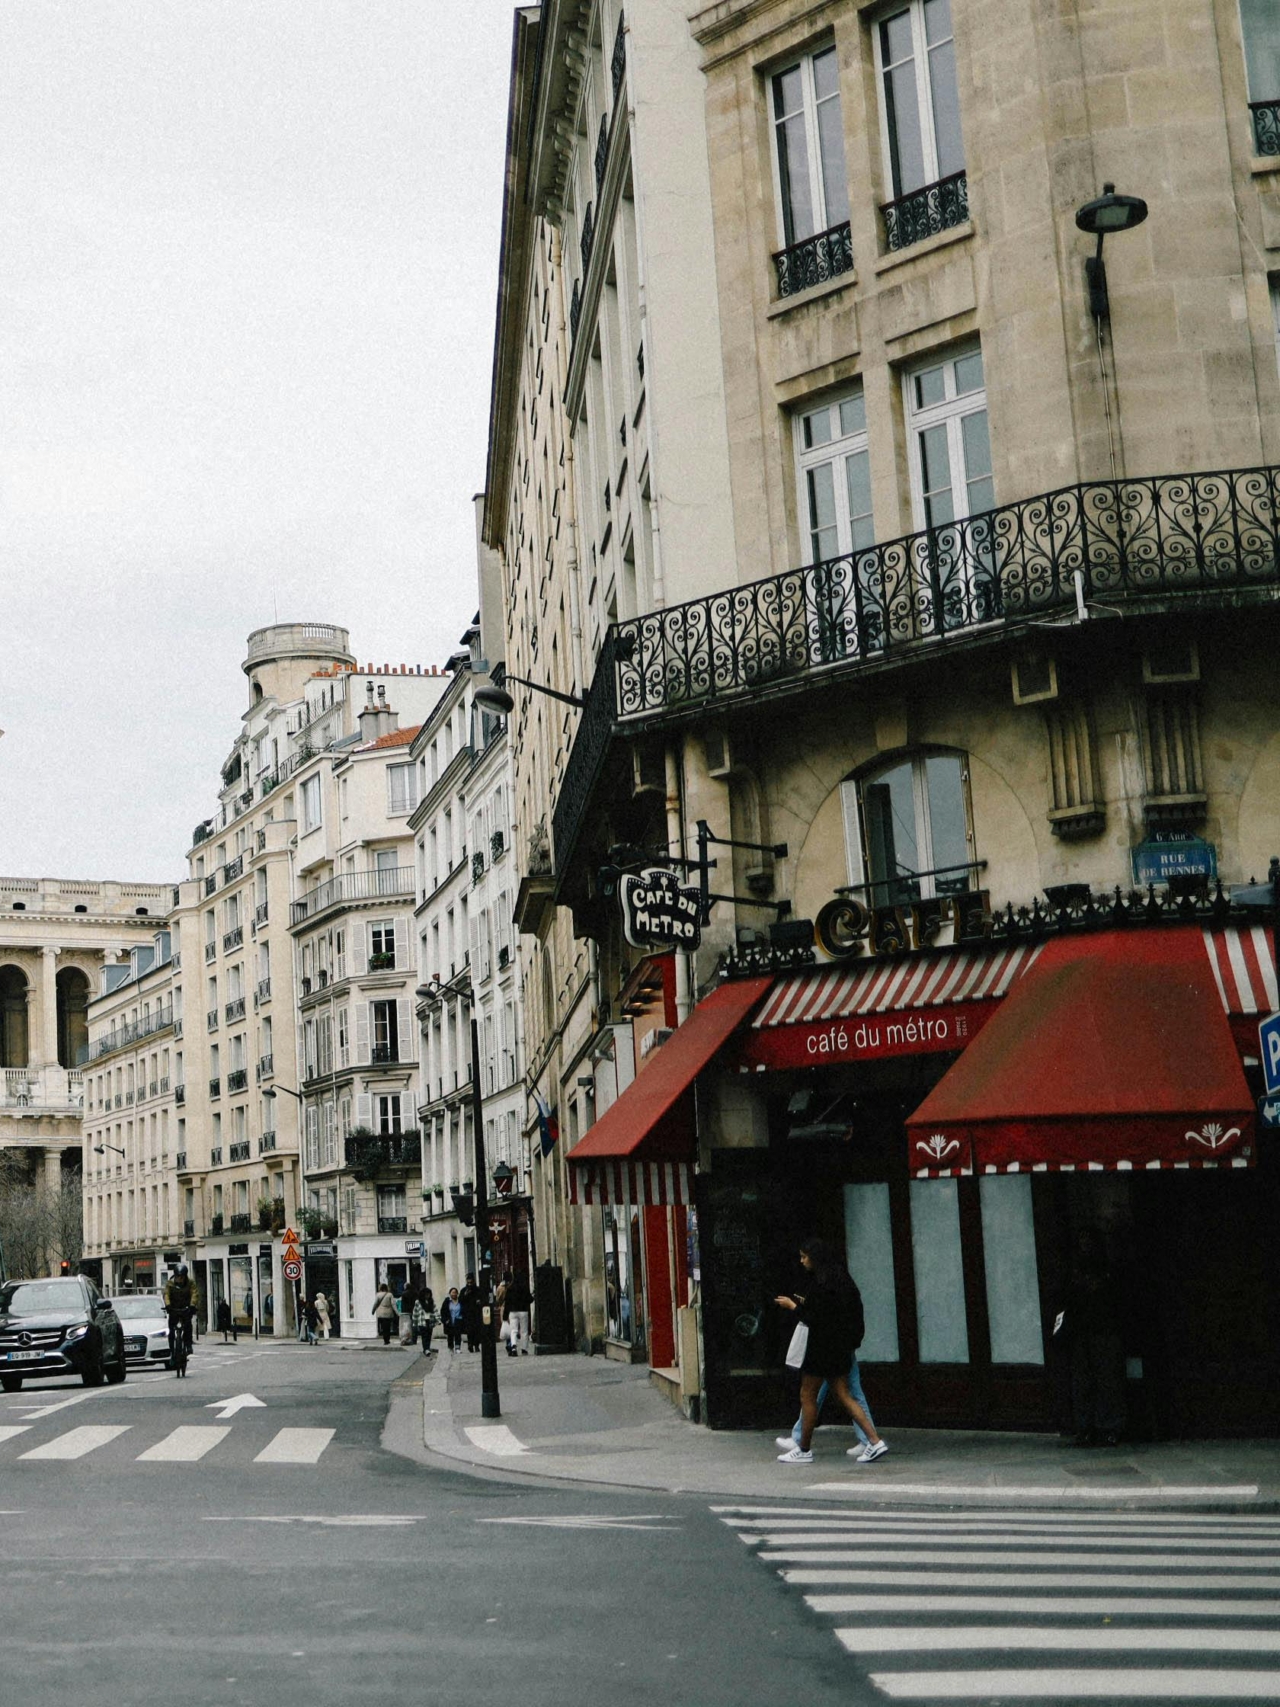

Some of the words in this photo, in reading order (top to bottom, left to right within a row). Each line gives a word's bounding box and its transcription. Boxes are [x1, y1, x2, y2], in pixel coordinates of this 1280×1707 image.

[1161, 853, 1185, 864] RUE
[1142, 867, 1157, 877] DE
[1161, 865, 1206, 876] RENNES
[678, 895, 697, 916] DU
[636, 910, 695, 937] METRO
[806, 1024, 848, 1054] café
[855, 1023, 880, 1048] du
[887, 1016, 948, 1044] métro
[1267, 1031, 1280, 1077] P
[287, 1266, 298, 1275] 30
